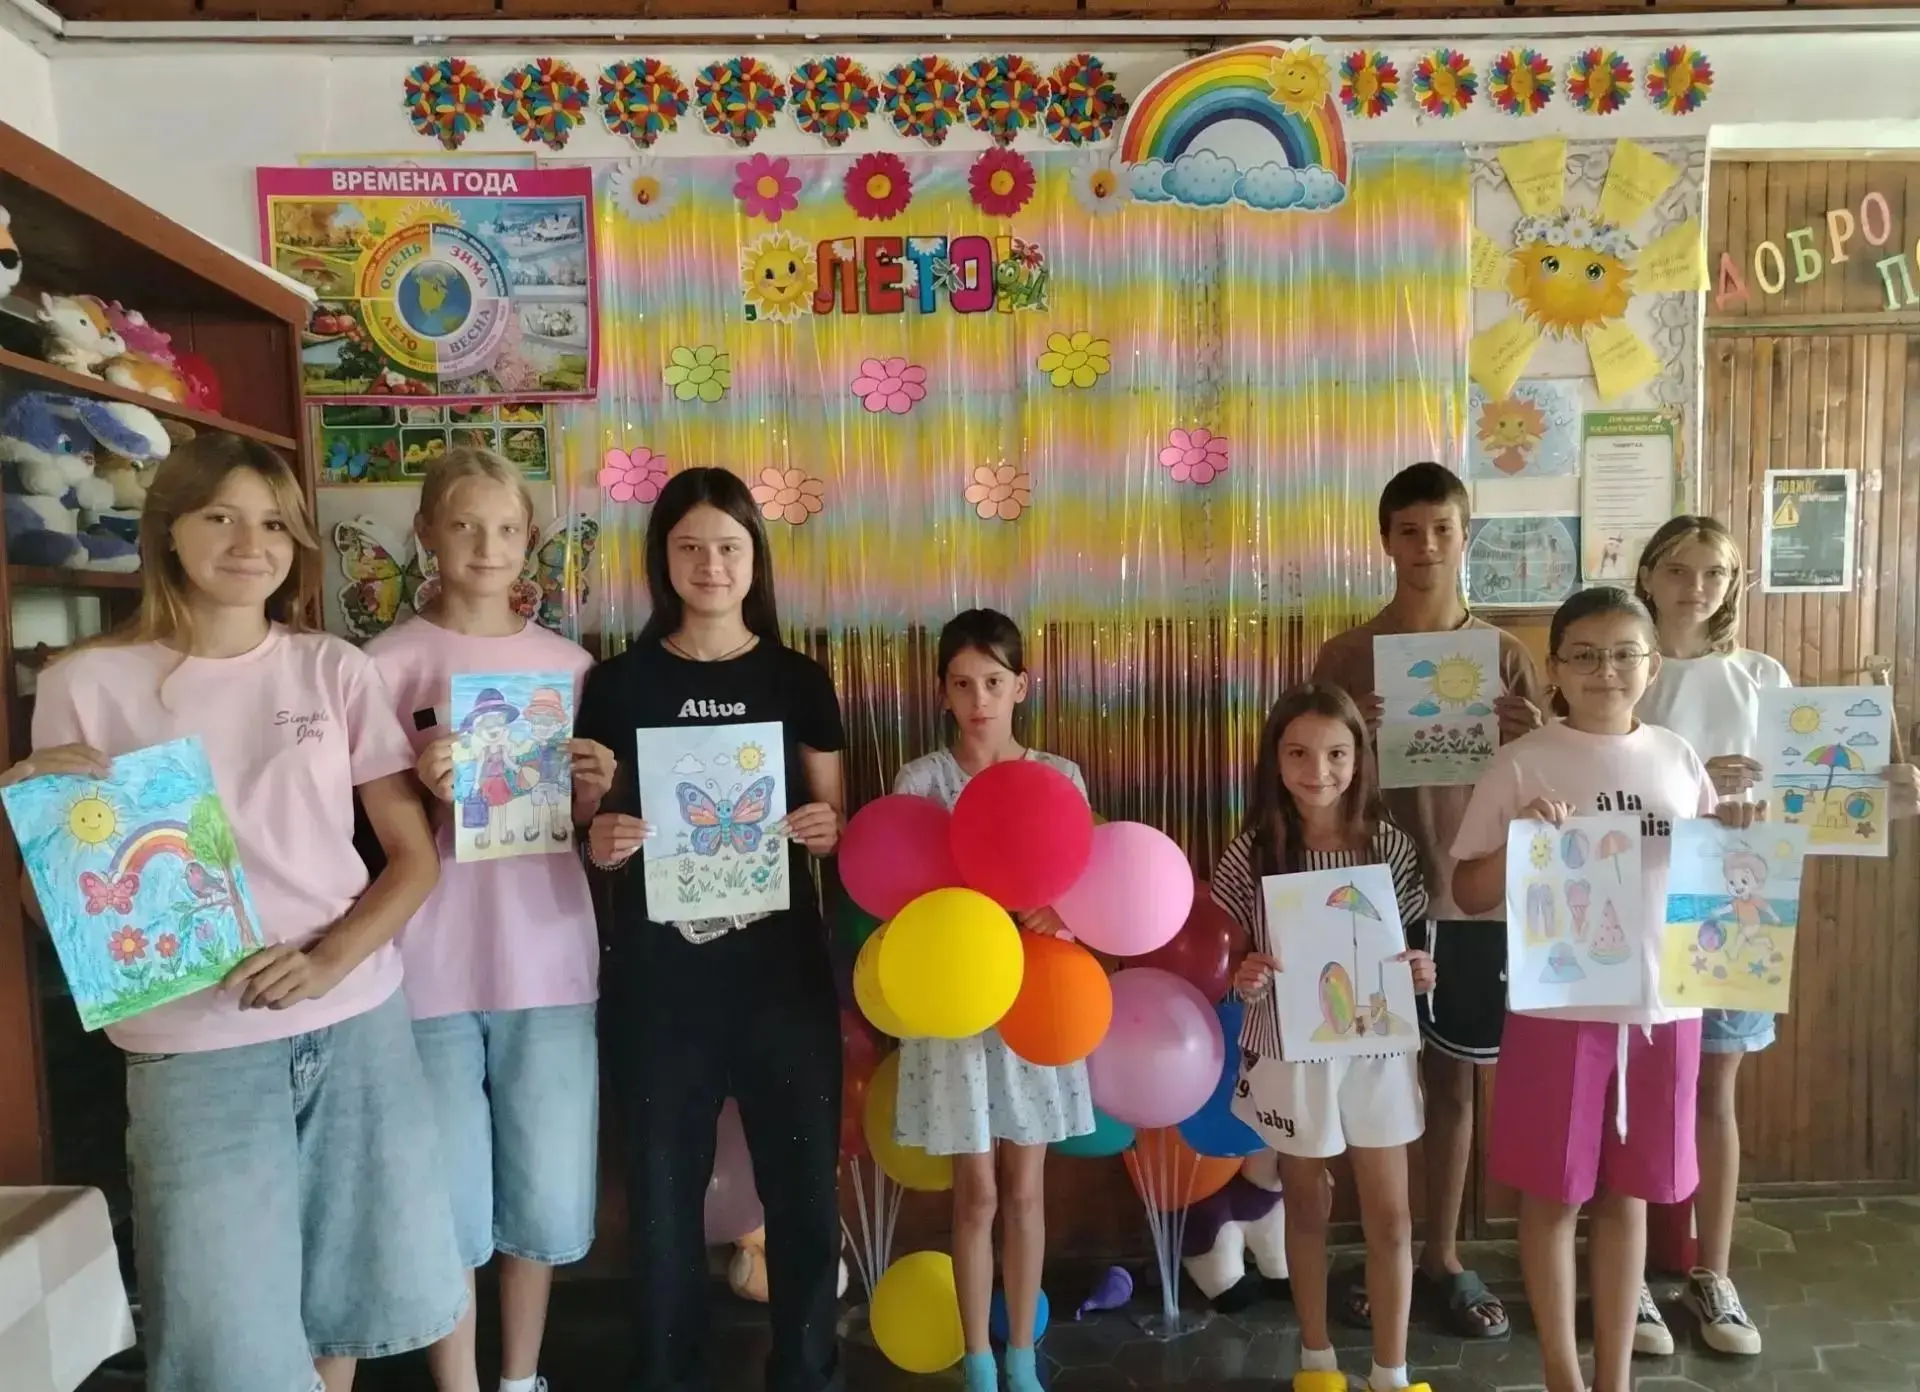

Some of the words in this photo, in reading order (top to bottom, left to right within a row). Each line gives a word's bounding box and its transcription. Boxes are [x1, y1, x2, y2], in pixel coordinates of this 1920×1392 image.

[331, 170, 448, 193] ВРЕМЕНА
[452, 172, 519, 196] ГОДА
[380, 243, 422, 290] ОСЕНЬ
[449, 245, 489, 288] ЗИМА
[1715, 191, 1892, 313] ДОБРО
[1875, 237, 1920, 311] П
[380, 316, 418, 351] ЛЕТО
[449, 309, 491, 353] ВЕСНА
[677, 698, 746, 718] Alive
[1616, 790, 1642, 811] la
